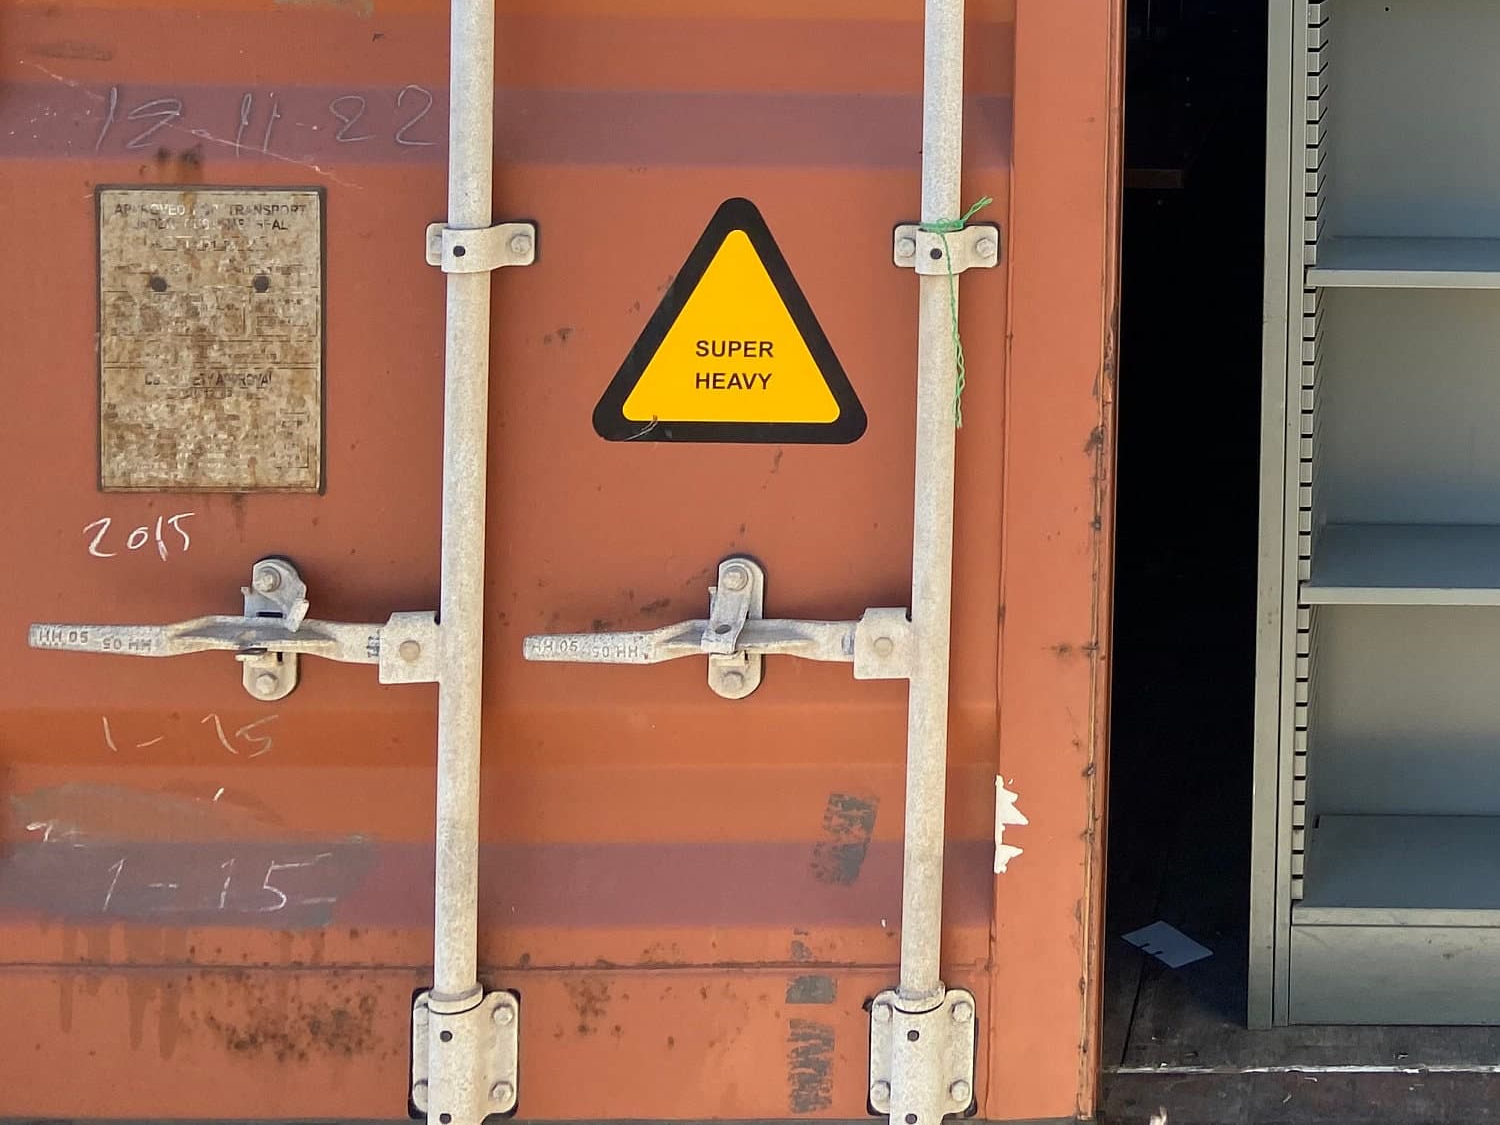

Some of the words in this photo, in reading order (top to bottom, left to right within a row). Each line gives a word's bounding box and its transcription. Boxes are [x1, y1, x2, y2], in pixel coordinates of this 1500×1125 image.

[695, 340, 774, 358] SUPER
[695, 373, 773, 390] HEAVY
[83, 512, 195, 562] 2015
